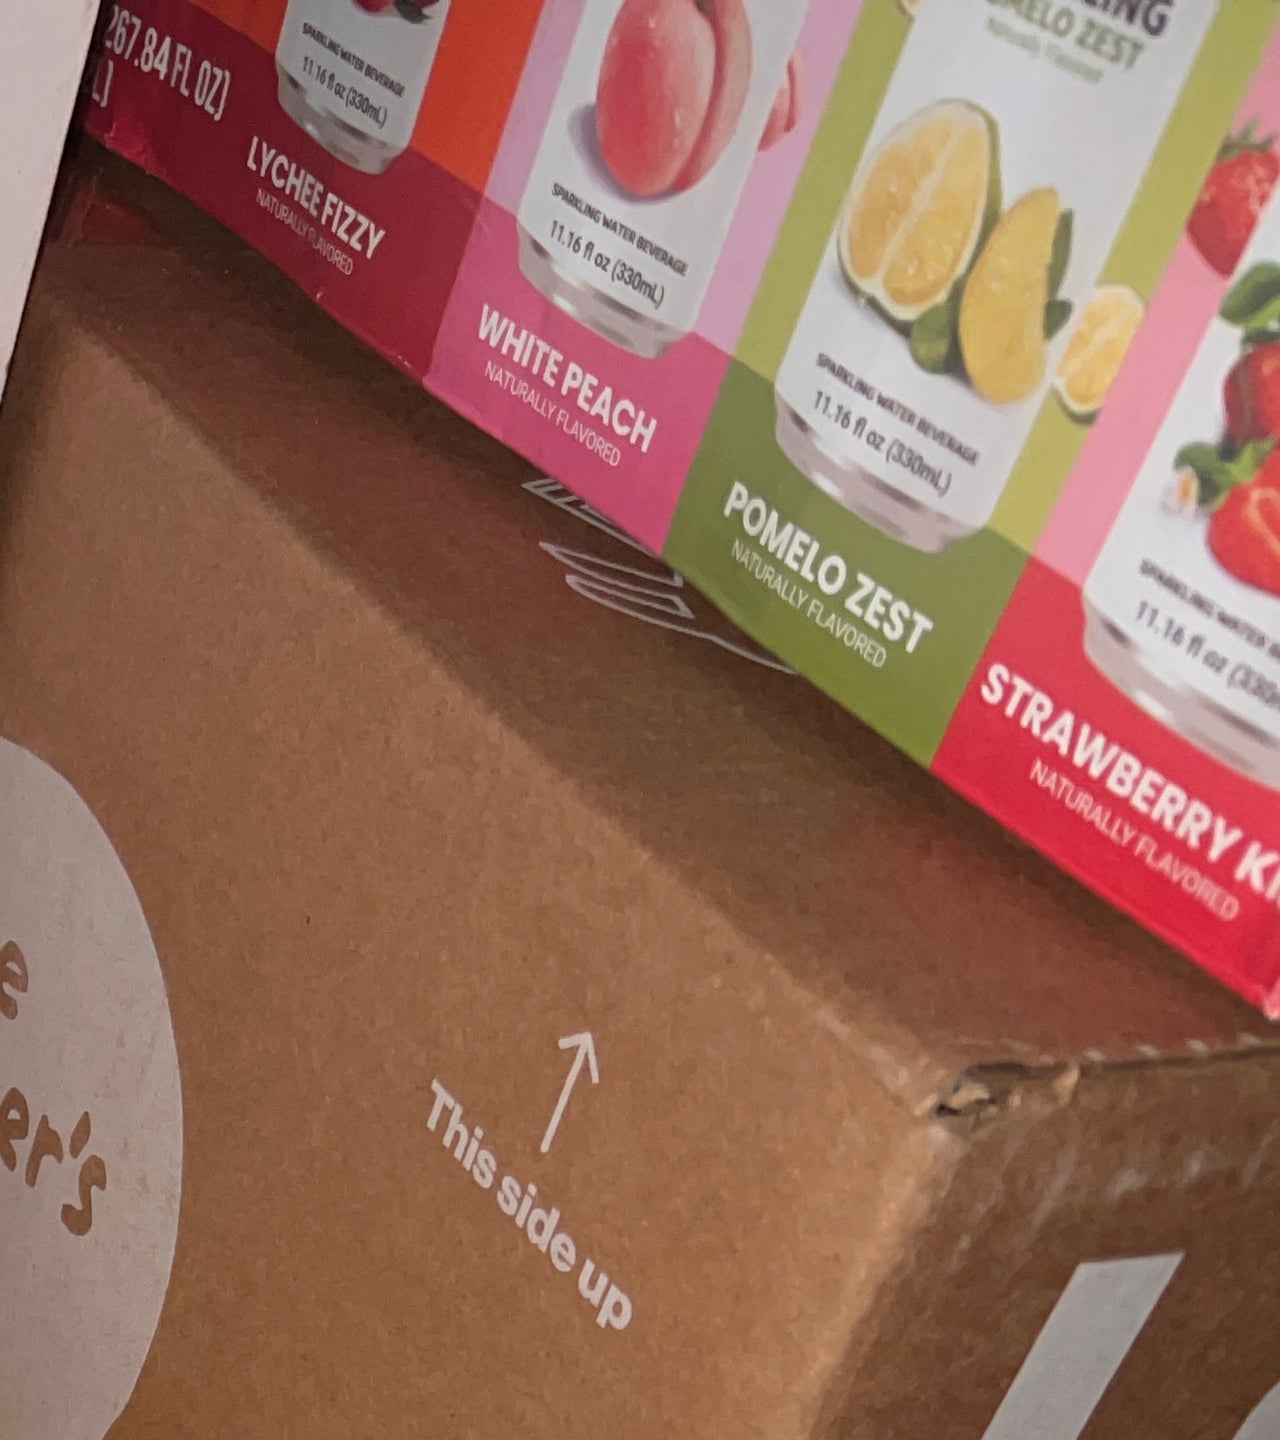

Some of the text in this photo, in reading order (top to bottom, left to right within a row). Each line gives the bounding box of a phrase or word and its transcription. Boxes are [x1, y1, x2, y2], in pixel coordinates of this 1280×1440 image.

[170, 43, 192, 98] FL
[194, 60, 231, 122] OZ)
[302, 22, 405, 98] SPARKLING WATER BEVERAGE
[302, 56, 388, 130] 11.16 fl oz (330mL)
[246, 135, 386, 260] LYCHEE FIZZY
[256, 188, 354, 276] NATURALLY FLAVORED
[551, 183, 688, 278] SPARKLING WATER BEVERAGE
[550, 220, 665, 311] 11.16 fl oz (330mL)
[478, 303, 657, 453] WHITE PEACH
[484, 360, 621, 467] NATURALLY FLAVORED
[816, 352, 875, 401] SPARKLING
[876, 392, 917, 427] WATER
[814, 391, 953, 498] 11.16 fl oz (330mL)
[724, 481, 934, 653] POMELO ZEST
[731, 538, 887, 668] NATURALLY FLAVORED
[981, 664, 1243, 863] STRAWBERRY
[1030, 759, 1240, 921] NATURALLY FLAVORED
[426, 1078, 632, 1331] This side up
